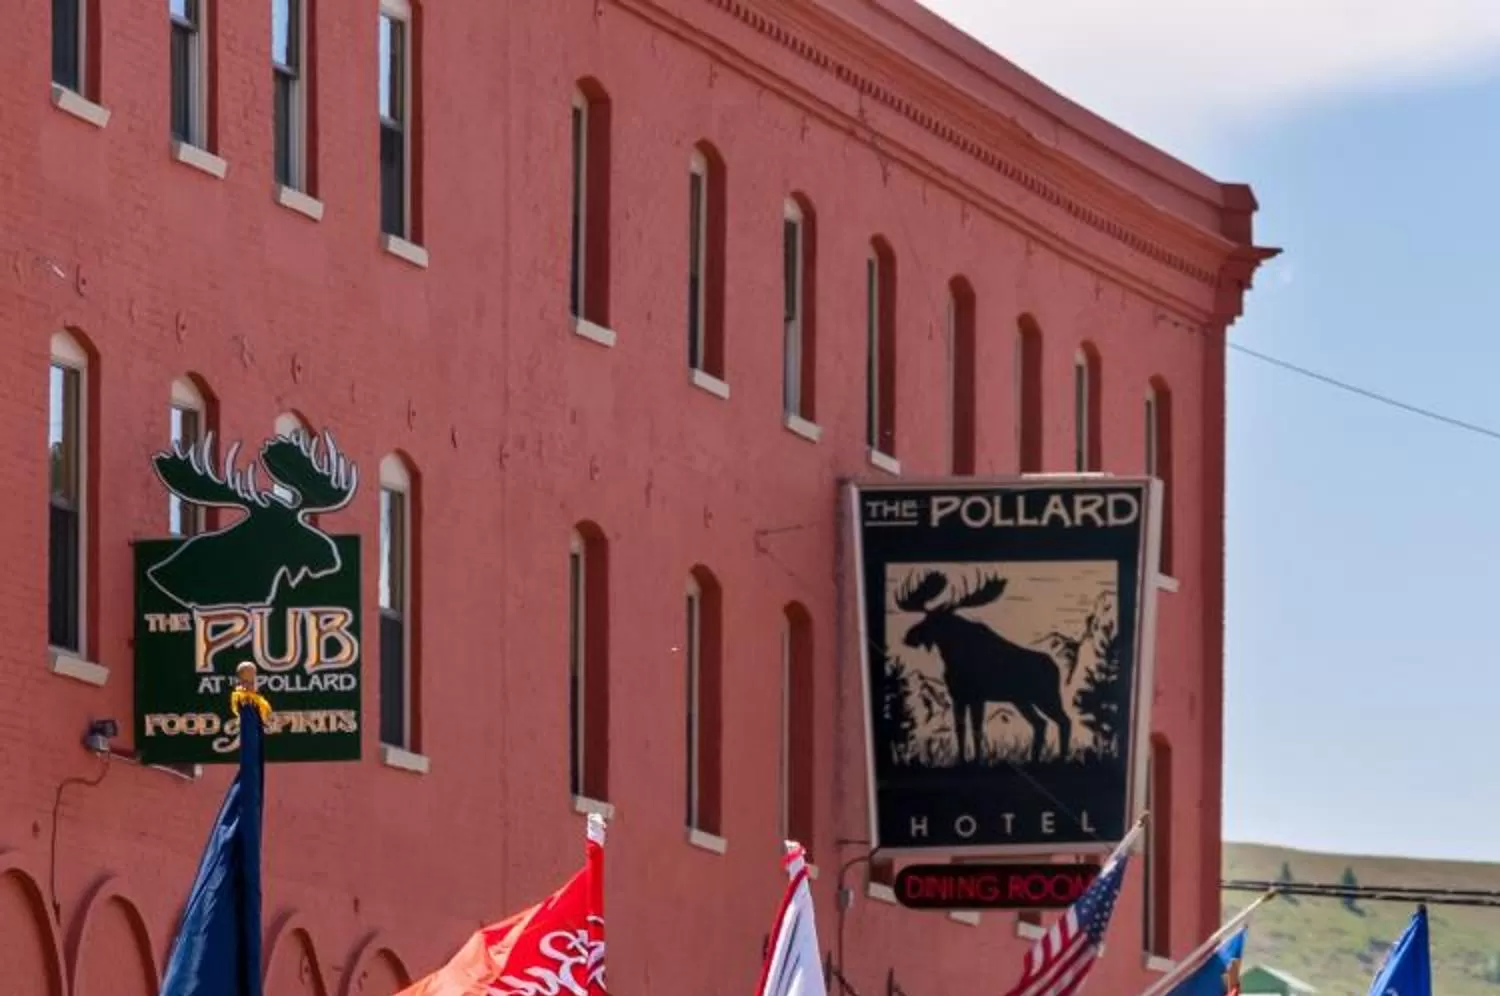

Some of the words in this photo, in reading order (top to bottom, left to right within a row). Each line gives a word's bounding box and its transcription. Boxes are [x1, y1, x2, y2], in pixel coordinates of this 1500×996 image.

[865, 501, 919, 518] THE
[931, 493, 1139, 529] POLLARD
[144, 613, 192, 632] THE
[193, 606, 359, 673] PUB
[198, 676, 223, 693] AT
[254, 673, 356, 693] POLLARD
[144, 713, 222, 737] FOOD
[262, 709, 358, 736] SPIRITS
[910, 811, 1097, 838] HOTEL
[904, 875, 1000, 901] DINING
